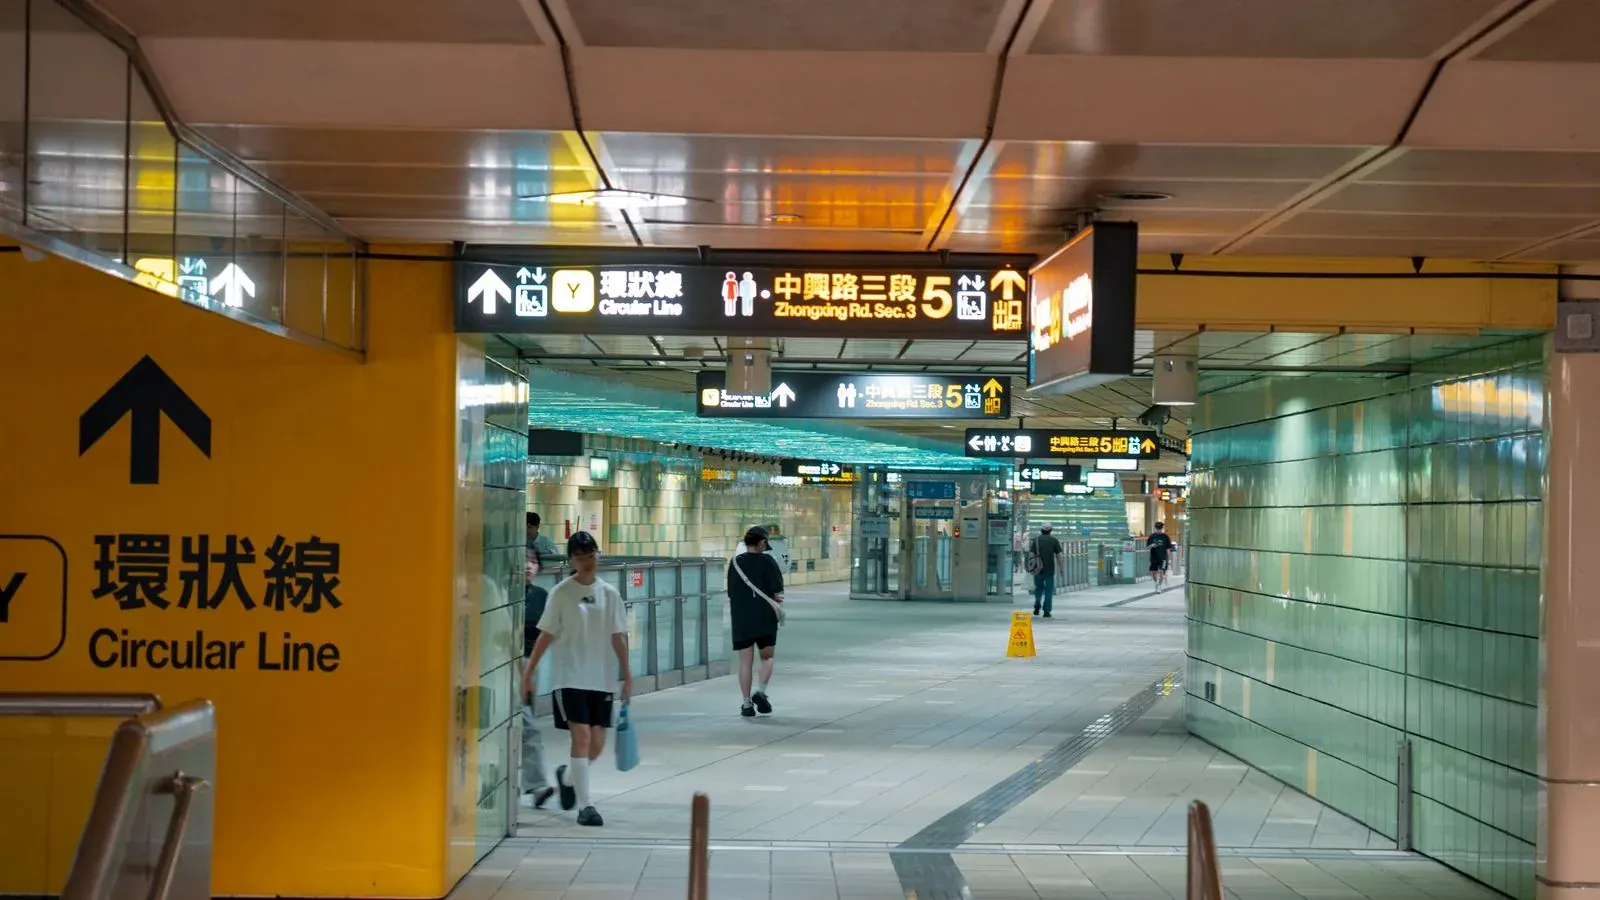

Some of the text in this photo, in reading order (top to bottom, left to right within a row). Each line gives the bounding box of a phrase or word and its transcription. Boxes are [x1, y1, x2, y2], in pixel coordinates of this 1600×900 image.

[567, 283, 580, 299] Y
[600, 270, 683, 298] 環狀線
[774, 272, 917, 301] 中興路三段
[599, 299, 682, 315] Circular Line
[774, 301, 848, 320] Zhongxing
[849, 302, 873, 318] Rd.
[874, 303, 905, 318] Sec.
[921, 276, 953, 319] 5
[993, 299, 1022, 330] 出口
[945, 384, 963, 408] 5
[1050, 436, 1099, 446] 中興路三段
[1100, 437, 1112, 453] 5
[91, 533, 343, 613] 環狀線
[88, 627, 341, 673] Circular Line
